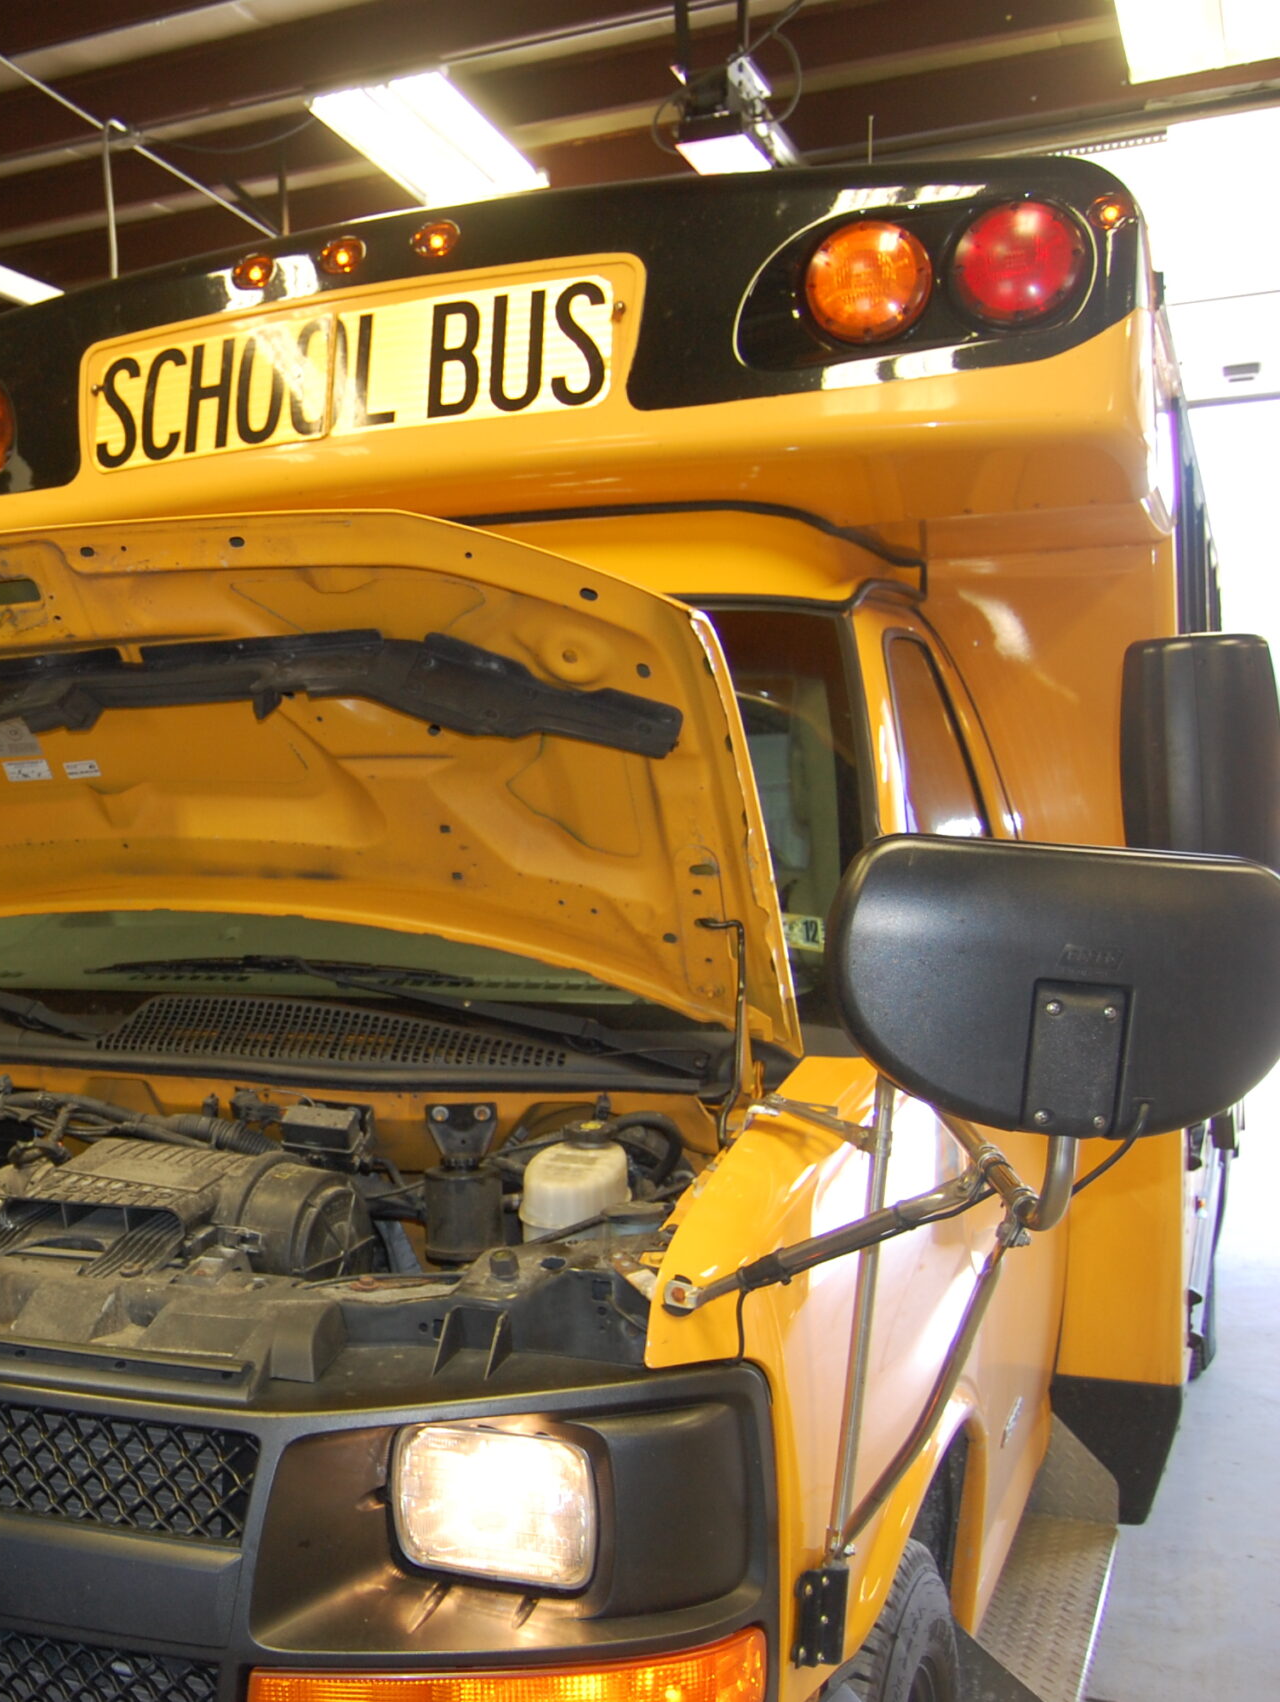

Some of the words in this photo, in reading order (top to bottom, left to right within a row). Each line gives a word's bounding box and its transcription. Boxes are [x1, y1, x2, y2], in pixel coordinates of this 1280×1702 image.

[96, 314, 396, 469] SCHOOL
[426, 281, 606, 419] BUS
[803, 919, 819, 944] 12
